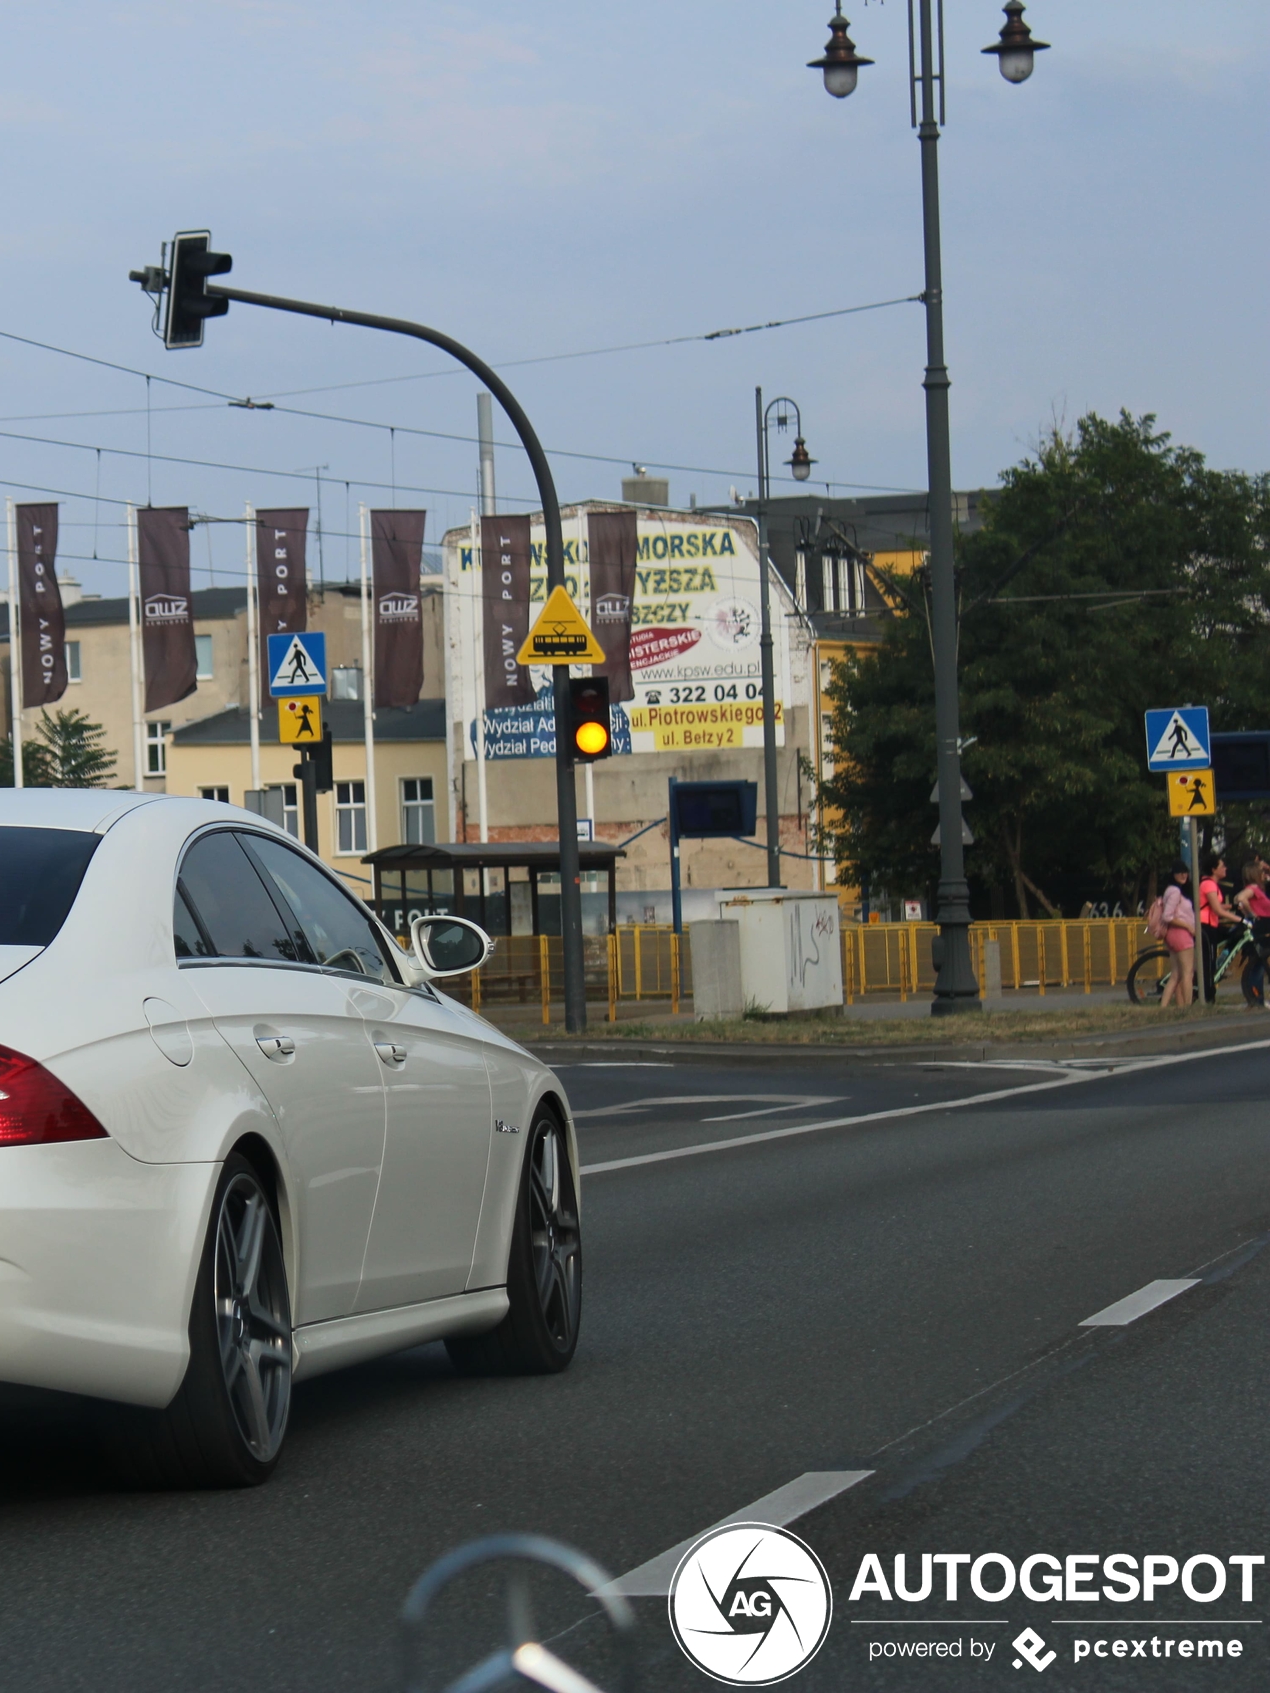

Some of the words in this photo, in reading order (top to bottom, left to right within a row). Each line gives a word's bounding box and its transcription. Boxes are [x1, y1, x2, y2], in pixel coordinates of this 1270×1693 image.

[275, 529, 288, 595] PORT
[500, 536, 513, 600] PORT
[39, 618, 54, 684] NOWY
[502, 624, 518, 687] NOWY
[629, 630, 700, 659] ISTERSKIE
[630, 648, 679, 670] ENCJACKIE
[641, 660, 760, 680] www.kpsw.edu.pl
[670, 686, 706, 703] 322
[714, 684, 738, 702] 04
[483, 715, 534, 738] Wydział
[632, 713, 647, 728] ul.
[649, 704, 765, 727] Piotrowskiego
[662, 731, 679, 746] ul.
